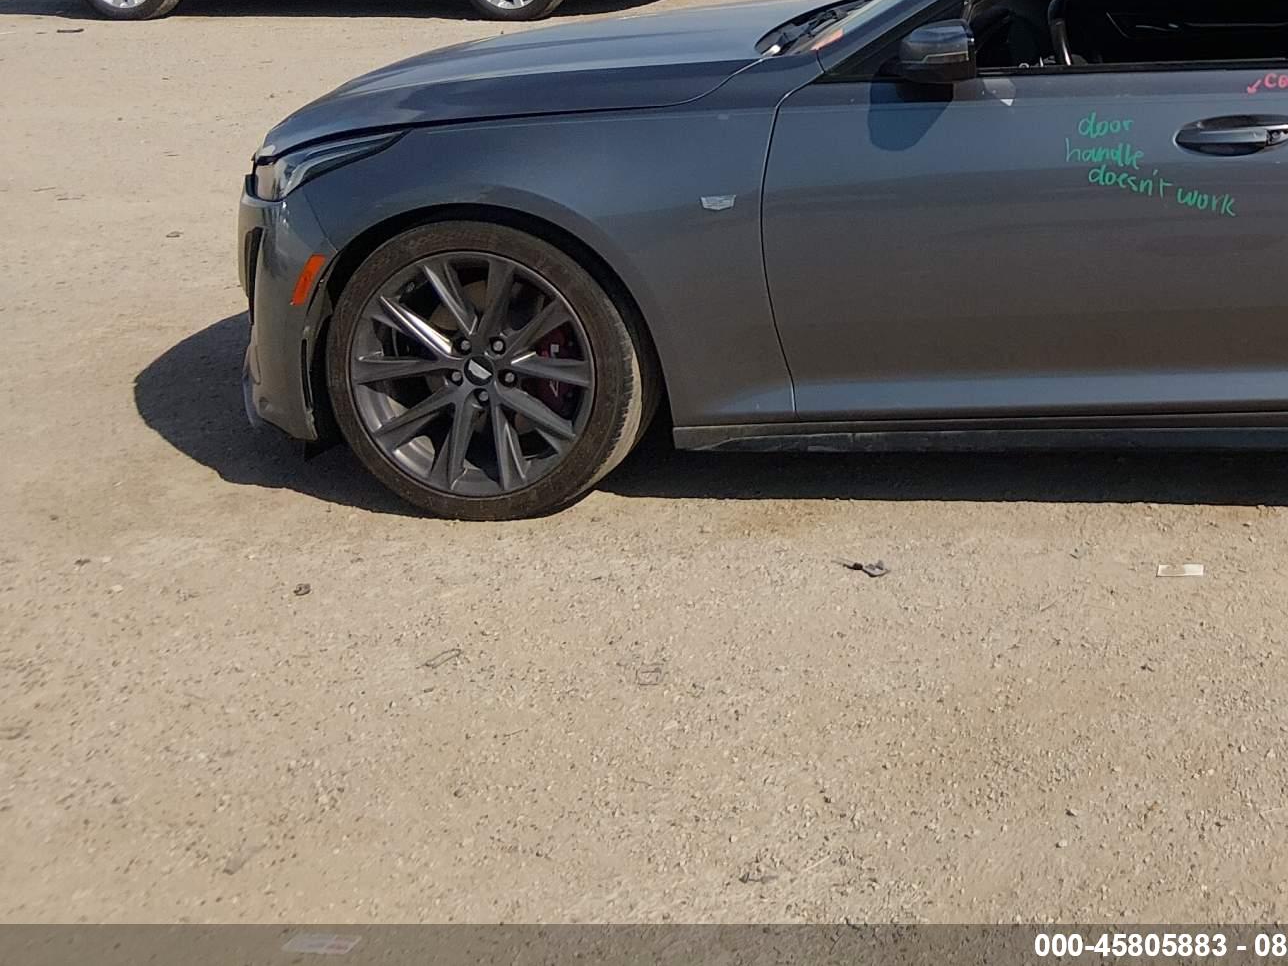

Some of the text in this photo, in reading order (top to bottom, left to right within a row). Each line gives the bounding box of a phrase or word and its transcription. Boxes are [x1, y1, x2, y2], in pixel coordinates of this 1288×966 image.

[1077, 111, 1134, 139] door
[1065, 137, 1144, 171] handle
[1087, 165, 1236, 217] doesn't work
